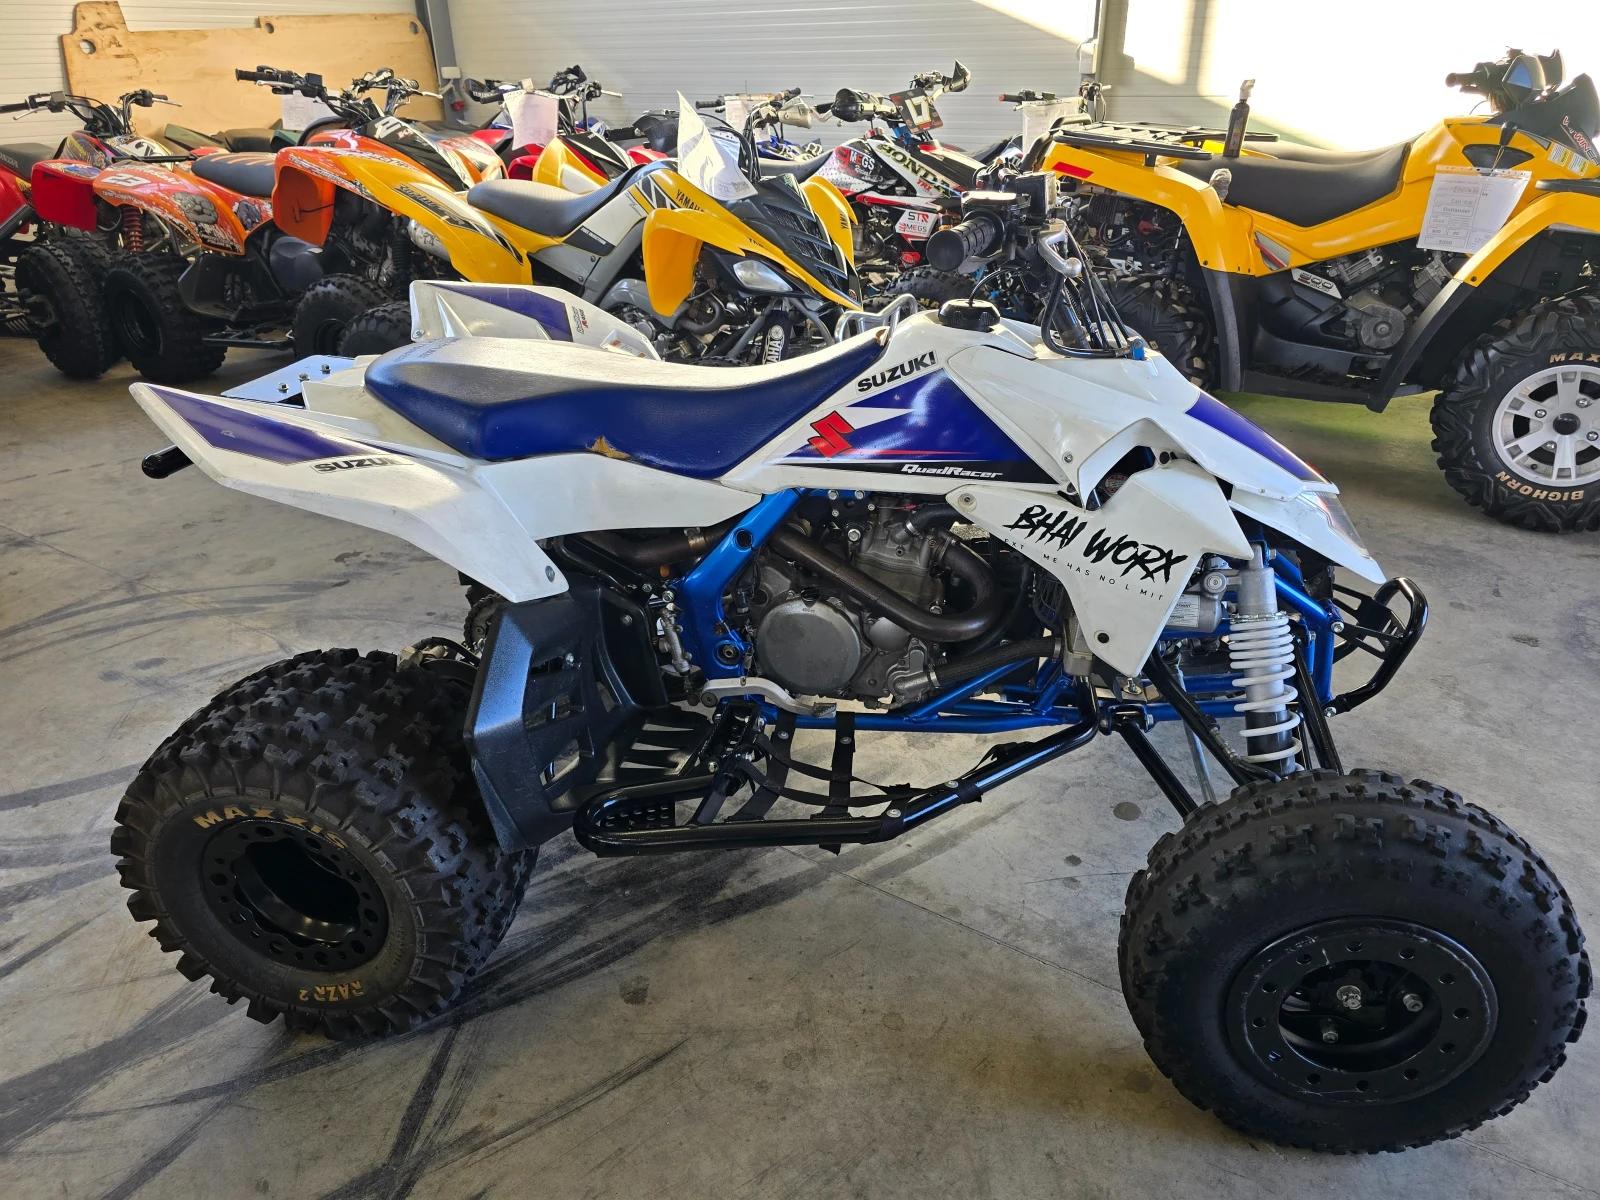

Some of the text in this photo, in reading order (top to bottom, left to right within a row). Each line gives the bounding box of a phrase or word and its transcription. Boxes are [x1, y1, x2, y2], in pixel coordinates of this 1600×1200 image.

[101, 173, 151, 188] 23
[879, 143, 952, 198] HONDA
[675, 188, 705, 213] YAMAH
[920, 297, 940, 309] MA
[857, 350, 937, 393] SUZUKI
[314, 457, 398, 472] SUZU
[901, 463, 1003, 480] QuadRacer
[1495, 470, 1585, 501] BIGHORN
[1002, 504, 1189, 584] BHAI WORX
[1099, 574, 1116, 585] NO
[1124, 584, 1164, 601] LMIT
[193, 805, 348, 849] MAXXIS
[299, 989, 309, 1001] 2
